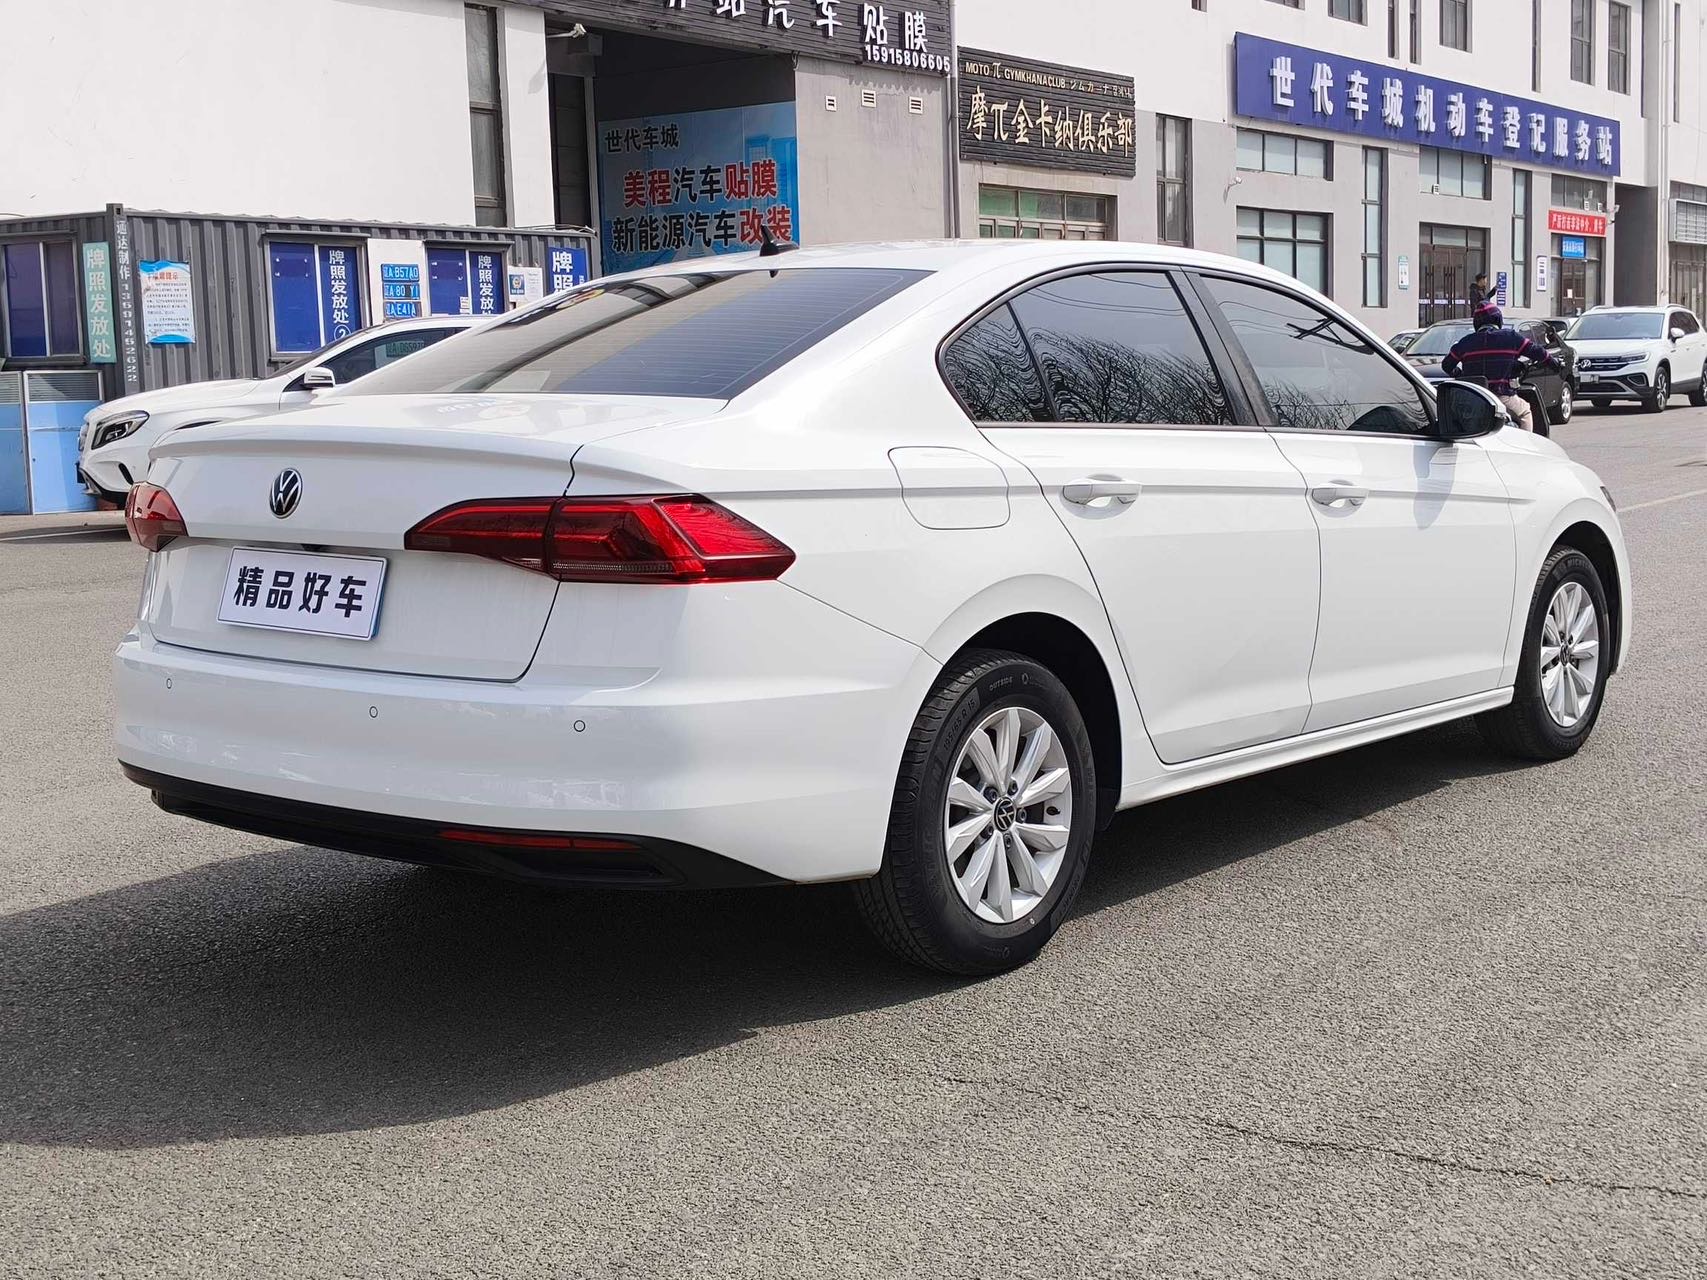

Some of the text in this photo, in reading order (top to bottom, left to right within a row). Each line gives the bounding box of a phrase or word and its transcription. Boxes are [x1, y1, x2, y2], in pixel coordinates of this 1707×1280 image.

[865, 44, 950, 71] 15915806605
[965, 62, 990, 76] MOTO
[1269, 56, 1613, 165] 世代车城机动车登记服务站
[604, 123, 680, 153] 世代车城
[623, 159, 777, 208] 美程汽车贴膜
[612, 204, 793, 253] 新能源汽车改装
[86, 248, 112, 358] 牌照发放处
[233, 565, 367, 618] 精品好车
